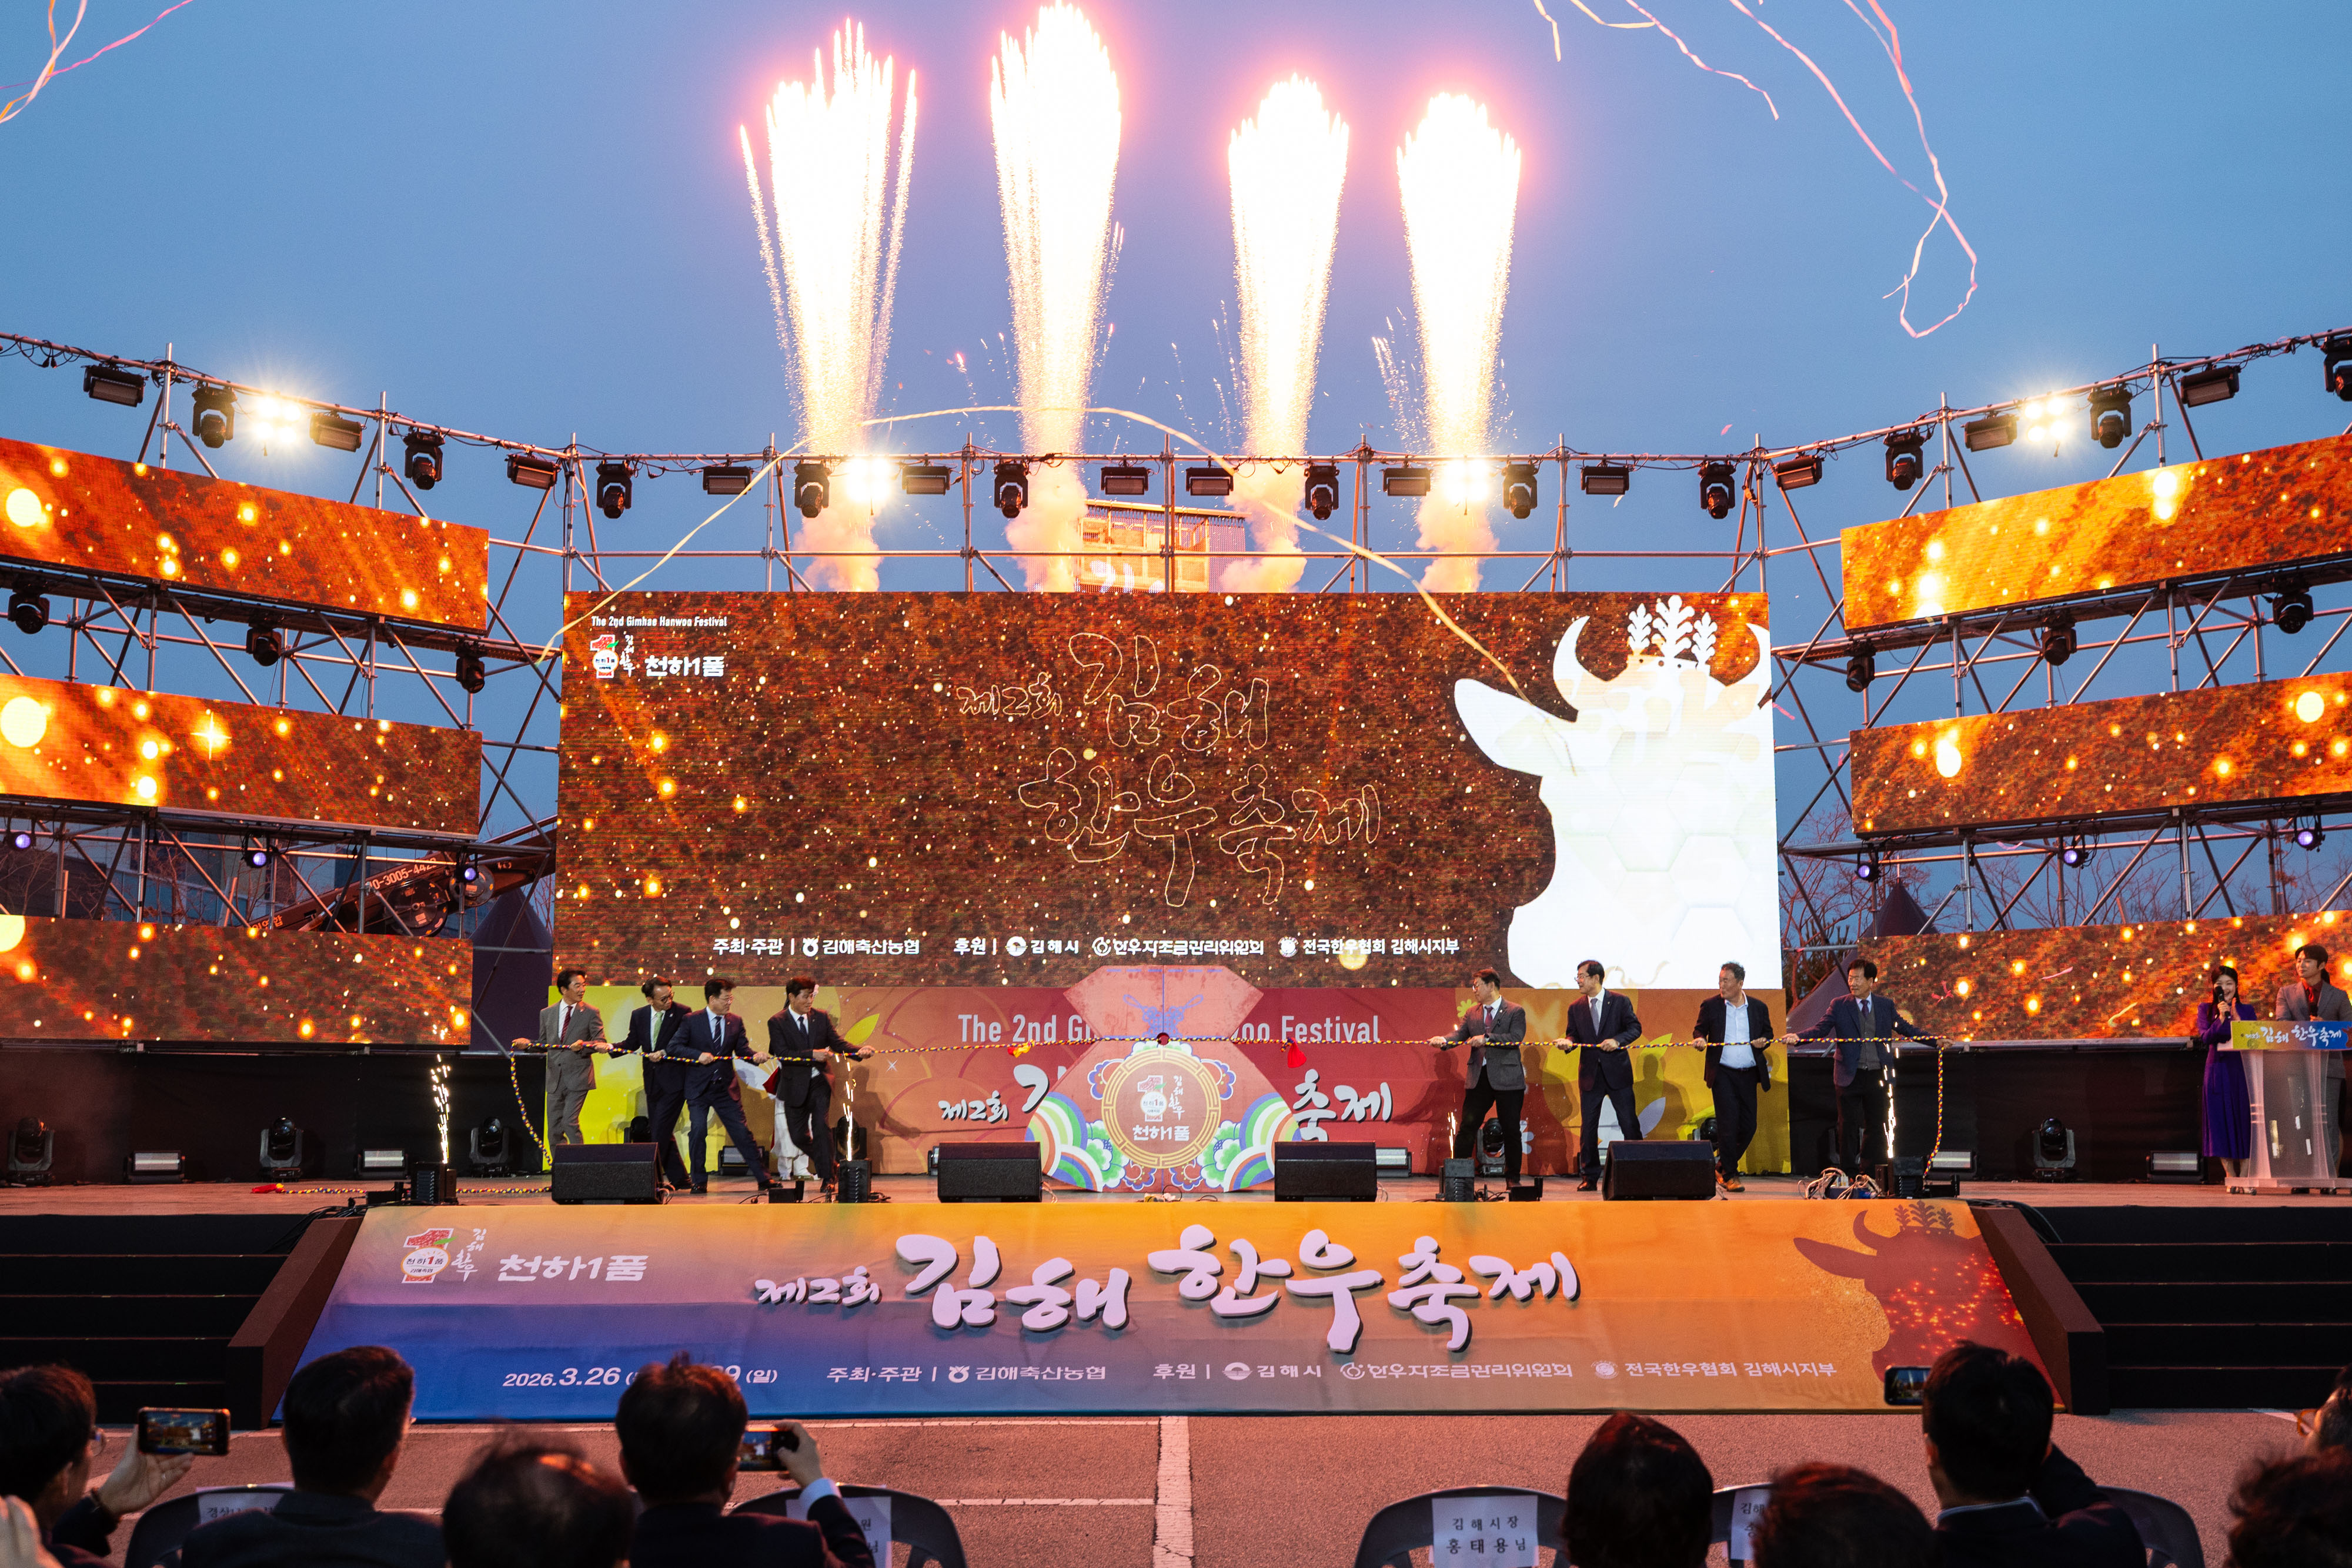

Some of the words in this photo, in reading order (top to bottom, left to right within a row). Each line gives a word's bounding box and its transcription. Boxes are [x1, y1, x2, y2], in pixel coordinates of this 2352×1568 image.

[592, 616, 606, 626] The
[609, 616, 624, 626] 2nd
[626, 616, 657, 626] Gimhae
[659, 616, 692, 626] Hanwoo
[694, 616, 727, 626] Festival
[644, 655, 724, 677] 천하1품
[957, 671, 1063, 720] 제2회
[1068, 632, 1269, 751] 김해
[713, 938, 784, 955] 주최·주관
[823, 938, 920, 955] 김해축산농협
[954, 938, 986, 956] 후원
[1031, 941, 1079, 954] 김해시
[1303, 937, 1385, 955] 전국한우협회
[1391, 937, 1459, 955] 김해시지부
[958, 1014, 1001, 1042] The
[1013, 1014, 1057, 1042] 2nd
[1282, 1015, 1380, 1042] Festival
[2260, 1026, 2289, 1044] 김해
[939, 1090, 1008, 1122] 제2회
[1132, 1125, 1190, 1141] 천하1품
[498, 1255, 649, 1281] 천하1품
[754, 1266, 880, 1306] 제2회
[896, 1235, 1130, 1331] 김해
[502, 1368, 621, 1387] 2026.3.26
[746, 1370, 778, 1383] (일)
[827, 1366, 922, 1383] 주최·주관
[975, 1366, 1105, 1381] 김해축산농협
[1153, 1363, 1196, 1379] 후원
[1257, 1364, 1321, 1379] 김해시
[1625, 1362, 1738, 1377] 전국한우협회
[1744, 1362, 1837, 1377] 김해시지부
